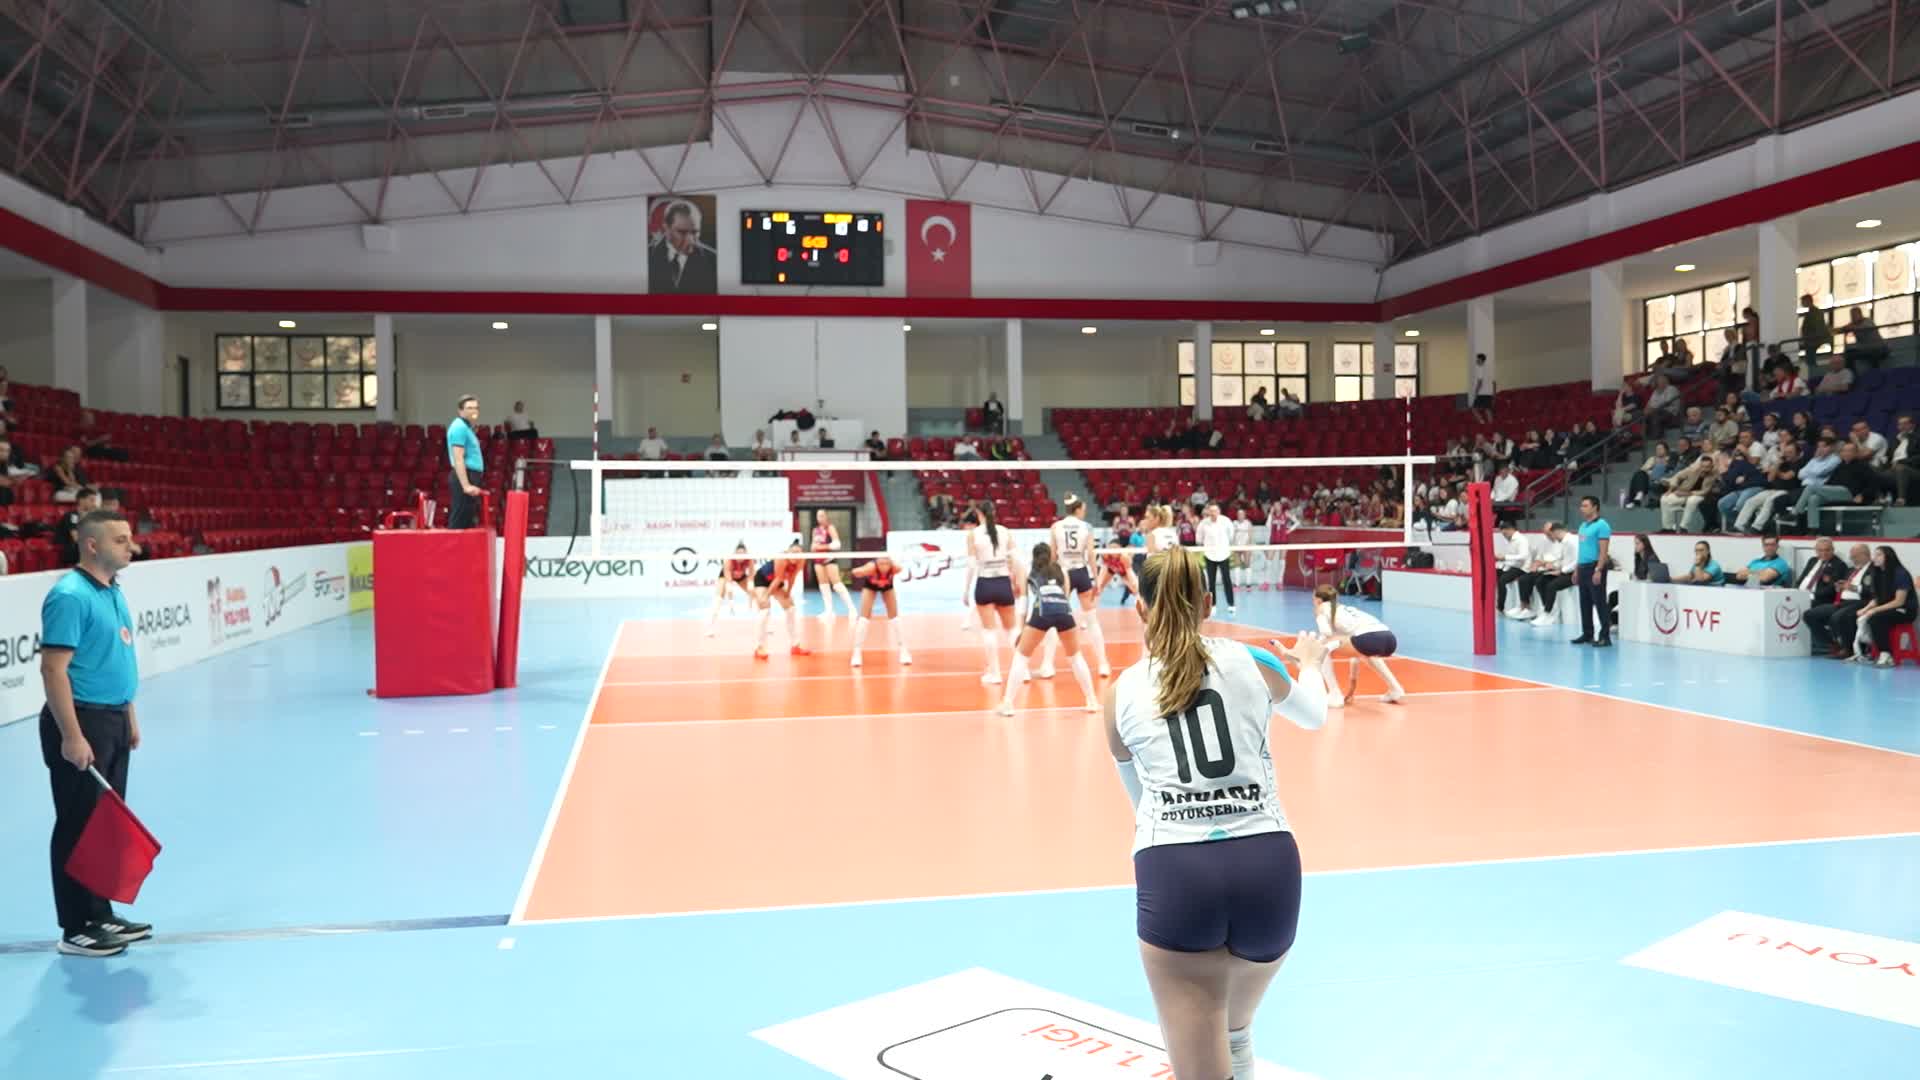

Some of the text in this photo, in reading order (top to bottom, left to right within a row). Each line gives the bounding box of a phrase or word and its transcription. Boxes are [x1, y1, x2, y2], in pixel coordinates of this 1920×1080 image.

[1064, 531, 1079, 550] 15
[136, 603, 192, 636] ARABICA
[1683, 608, 1721, 632] TVF
[1778, 633, 1799, 643] TVF
[1163, 688, 1234, 784] 10
[1021, 1024, 1111, 1054] LİGİ
